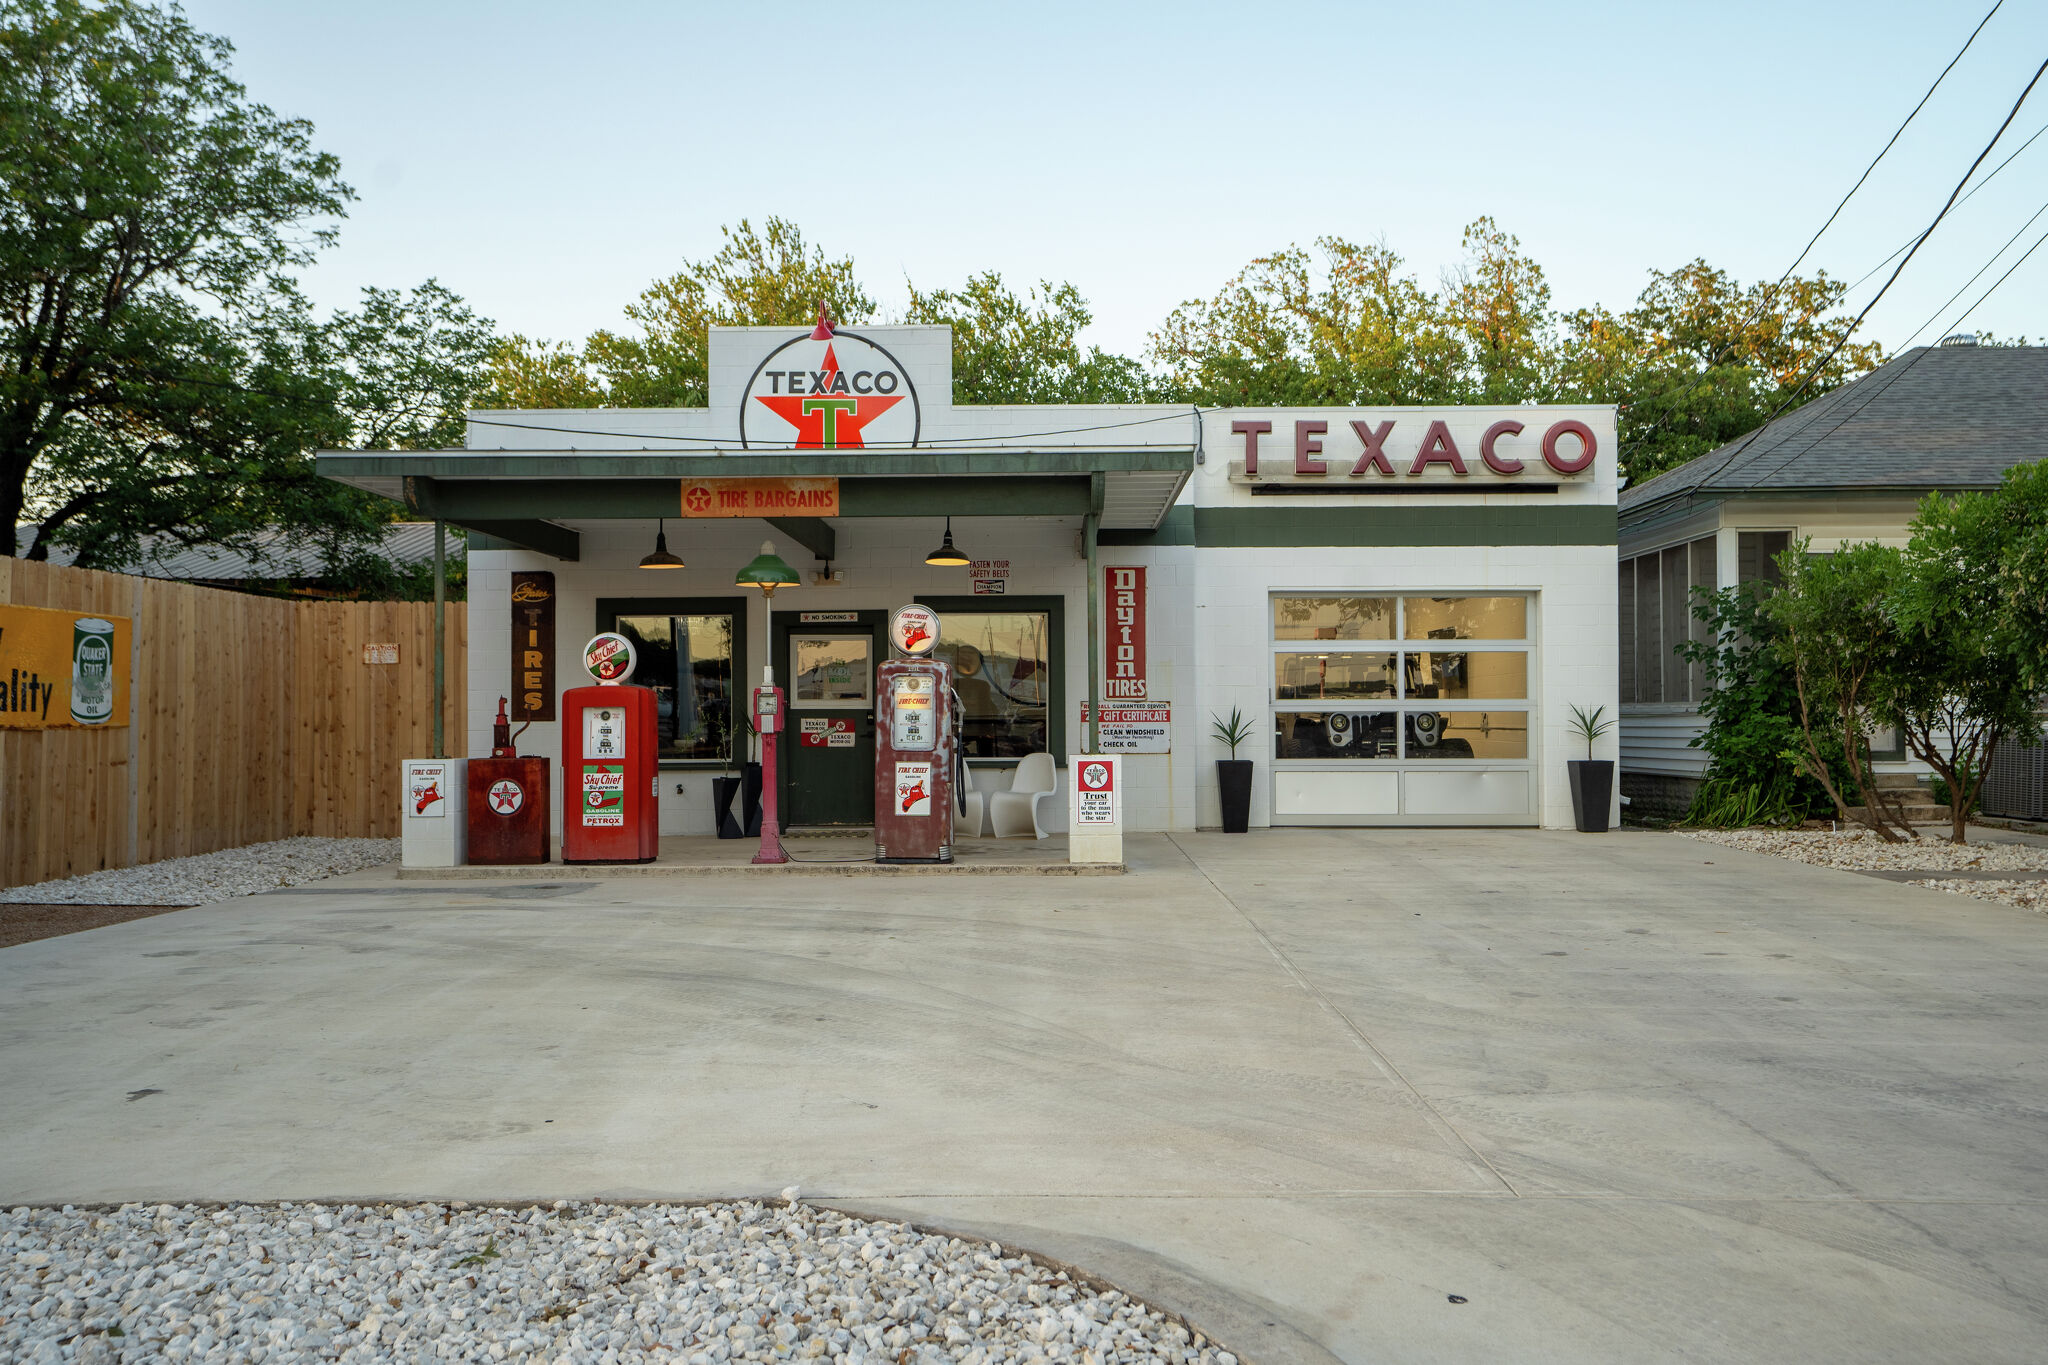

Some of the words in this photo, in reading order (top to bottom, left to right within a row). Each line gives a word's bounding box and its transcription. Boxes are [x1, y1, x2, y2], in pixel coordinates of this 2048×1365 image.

[765, 370, 899, 395] TEXACO
[1230, 419, 1598, 476] TEXACO
[718, 490, 748, 508] TIRE
[754, 490, 833, 508] BARGAINS
[969, 560, 991, 569] FASTEN
[993, 560, 1010, 569] YOUR
[969, 570, 991, 578] SAFETY
[993, 570, 1010, 578] BELTS
[1114, 569, 1136, 678] Dayton
[81, 646, 107, 661] QUAKER
[523, 608, 543, 711] TIRES
[590, 651, 603, 665] Sky
[602, 640, 619, 658] Chief
[83, 663, 104, 677] STATE
[1107, 679, 1146, 697] TIRES
[81, 695, 105, 705] MOTOR
[86, 705, 99, 714] OIL
[1103, 711, 1121, 721] GIFT
[1122, 711, 1168, 721] CERTIFICATE
[584, 774, 600, 785] Sky
[601, 774, 622, 784] Chief
